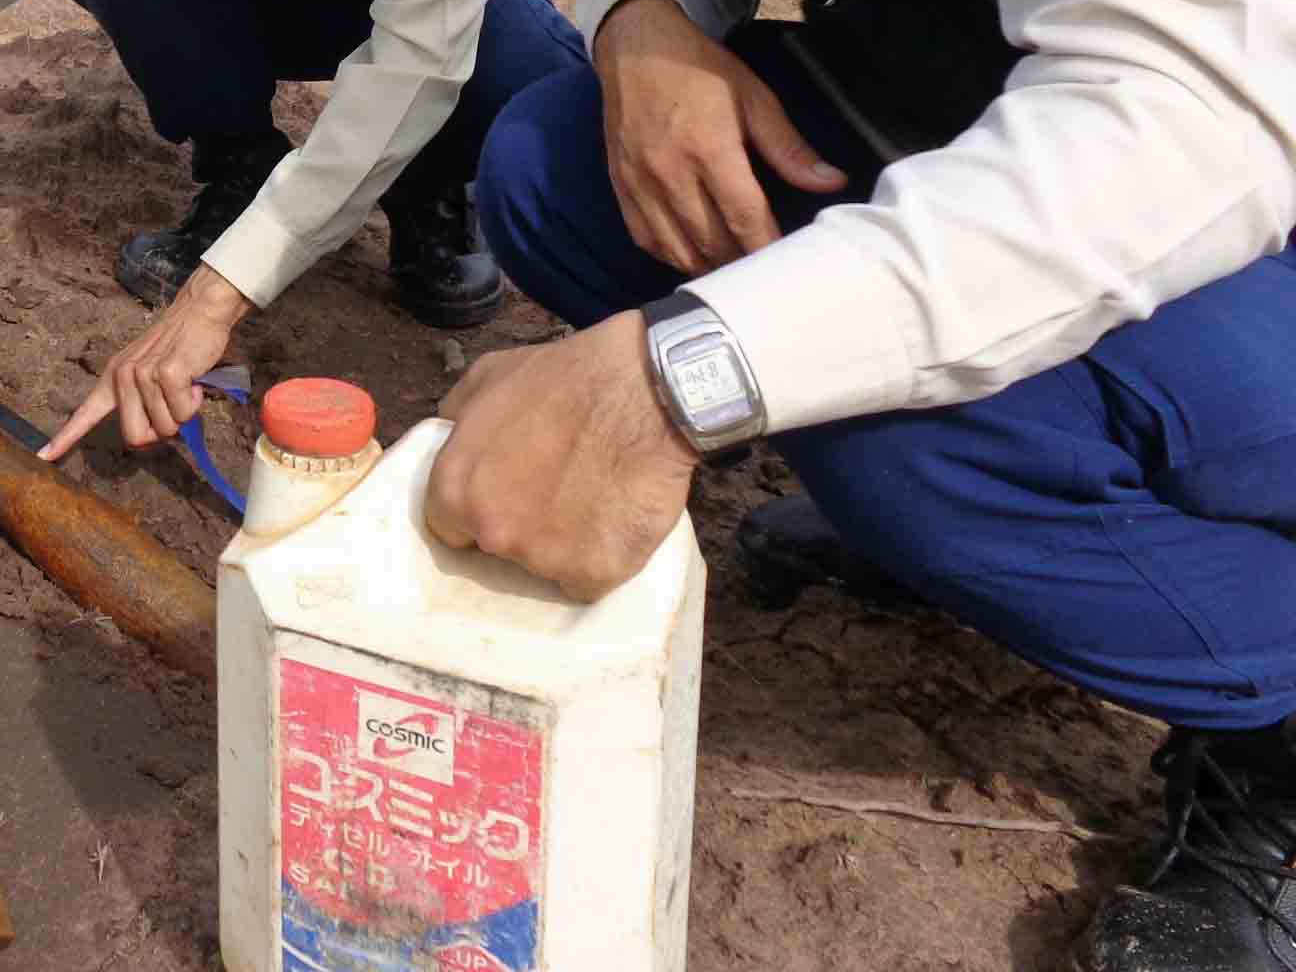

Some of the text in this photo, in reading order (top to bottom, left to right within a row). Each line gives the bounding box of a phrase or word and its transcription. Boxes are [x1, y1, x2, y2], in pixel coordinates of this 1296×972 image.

[365, 718, 448, 754] COSMIC
[287, 745, 530, 861] コスミック
